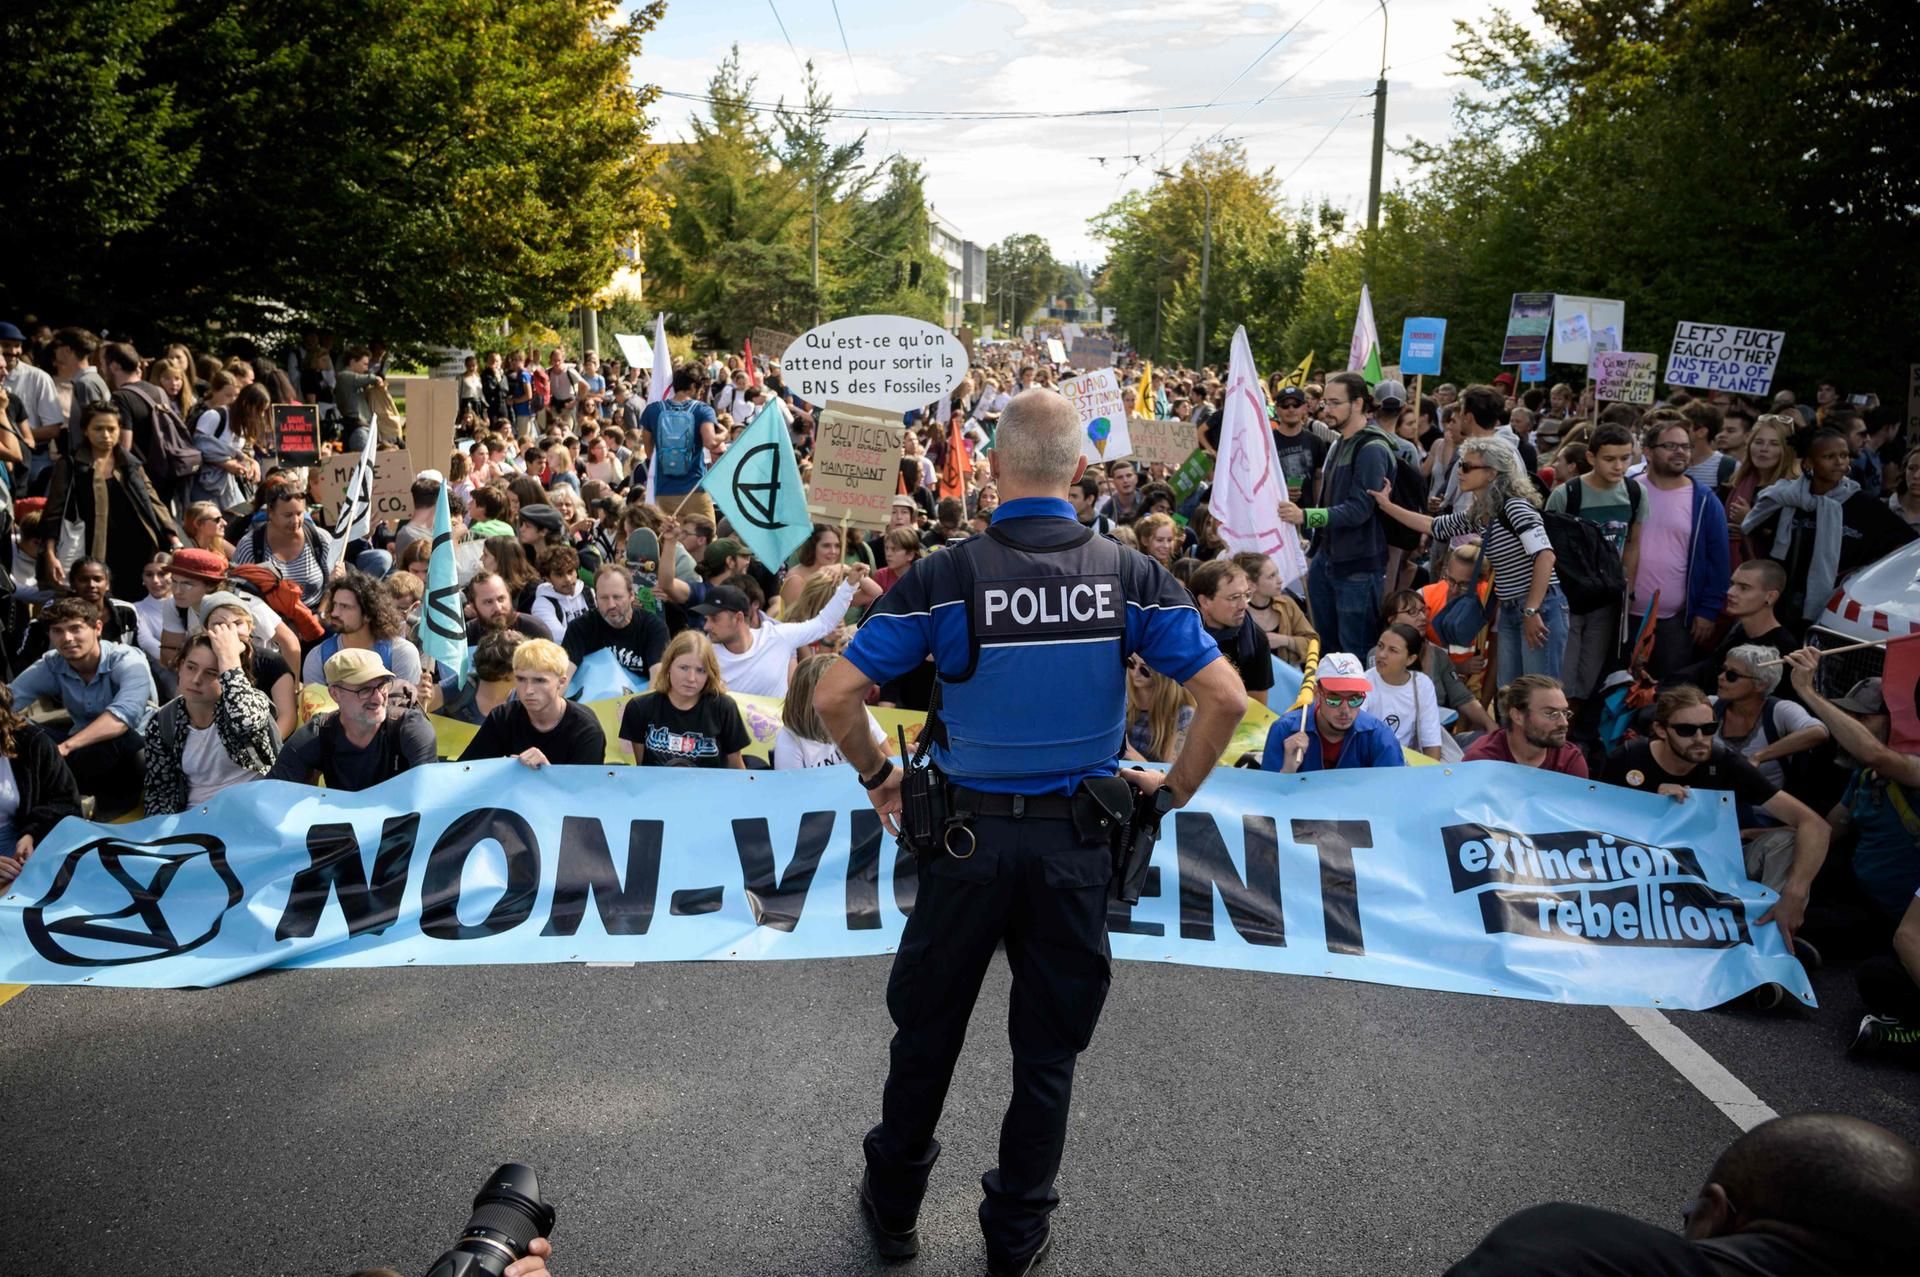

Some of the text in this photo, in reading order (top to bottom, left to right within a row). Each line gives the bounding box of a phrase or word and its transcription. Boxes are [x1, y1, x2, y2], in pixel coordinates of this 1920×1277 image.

[805, 331, 891, 350] Qu'est-ce
[898, 330, 945, 350] qu'on
[1677, 323, 1780, 350] LET'S FUCK
[1673, 341, 1776, 366] EACH OTHER
[785, 354, 953, 374] attend pour sortir la
[1672, 356, 1769, 377] INSTEAD OF
[803, 380, 839, 394] BNS
[848, 379, 875, 393] des
[884, 379, 940, 393] Fossiles
[1064, 375, 1107, 397] QUAND
[1667, 370, 1699, 385] OUR
[1708, 374, 1770, 393] PLANET
[1097, 403, 1123, 416] FOUTU
[824, 423, 901, 449] POLITICIENS
[1142, 422, 1165, 435] YOU
[835, 448, 882, 465] AGISSEZ
[334, 465, 381, 483] MAE
[821, 461, 887, 480] MAINTENANT
[846, 477, 859, 489] OU
[985, 584, 1115, 626] POLICE
[1459, 833, 1679, 882] extinction
[1537, 883, 1741, 942] rebellion
